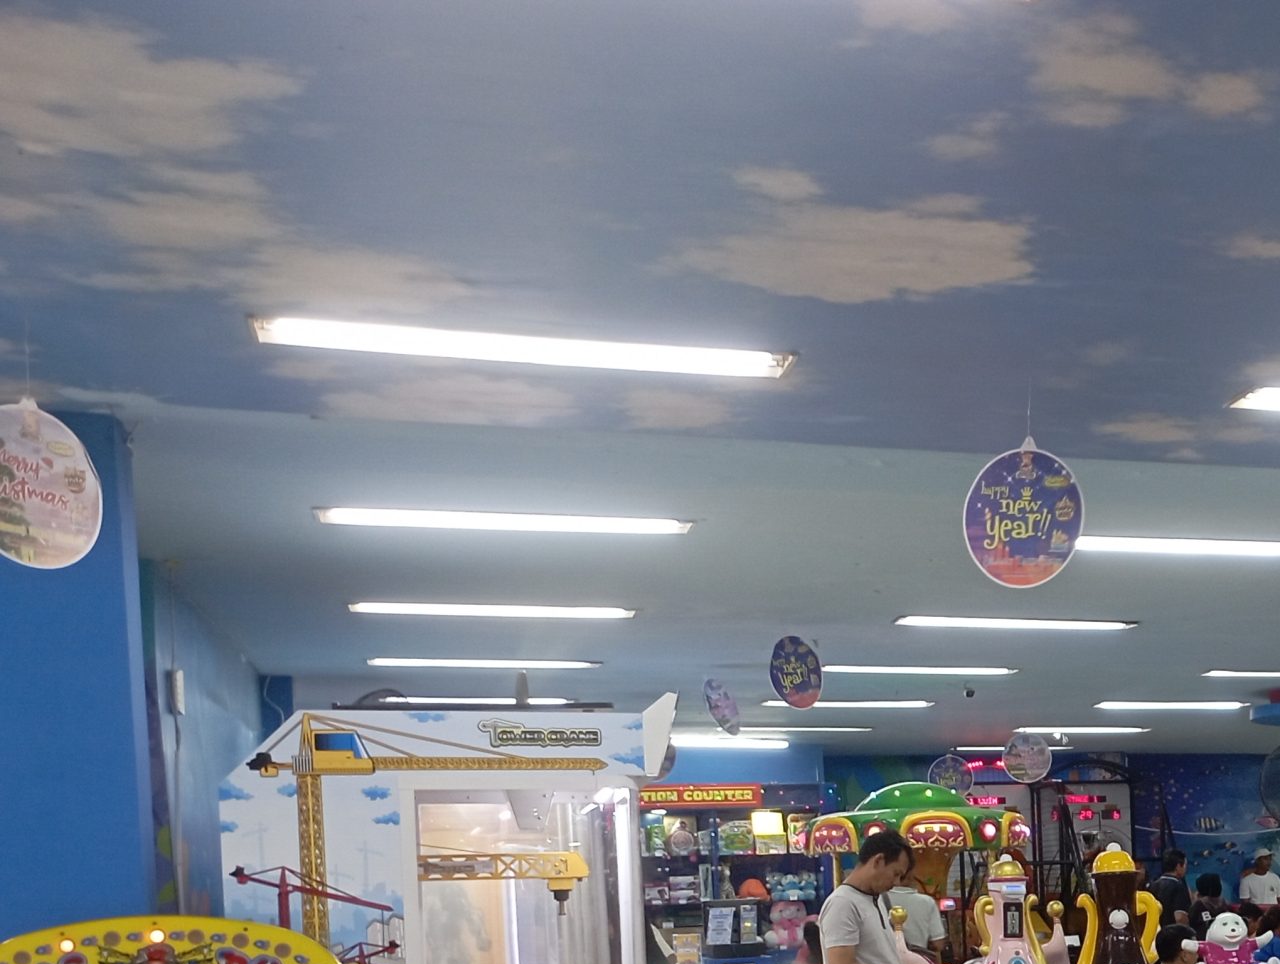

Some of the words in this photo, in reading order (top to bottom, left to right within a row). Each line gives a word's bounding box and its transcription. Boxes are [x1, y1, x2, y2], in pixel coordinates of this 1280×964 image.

[981, 481, 1009, 500] happy
[999, 499, 1042, 517] new
[547, 729, 600, 746] CRANE
[683, 790, 753, 801] COUNTER
